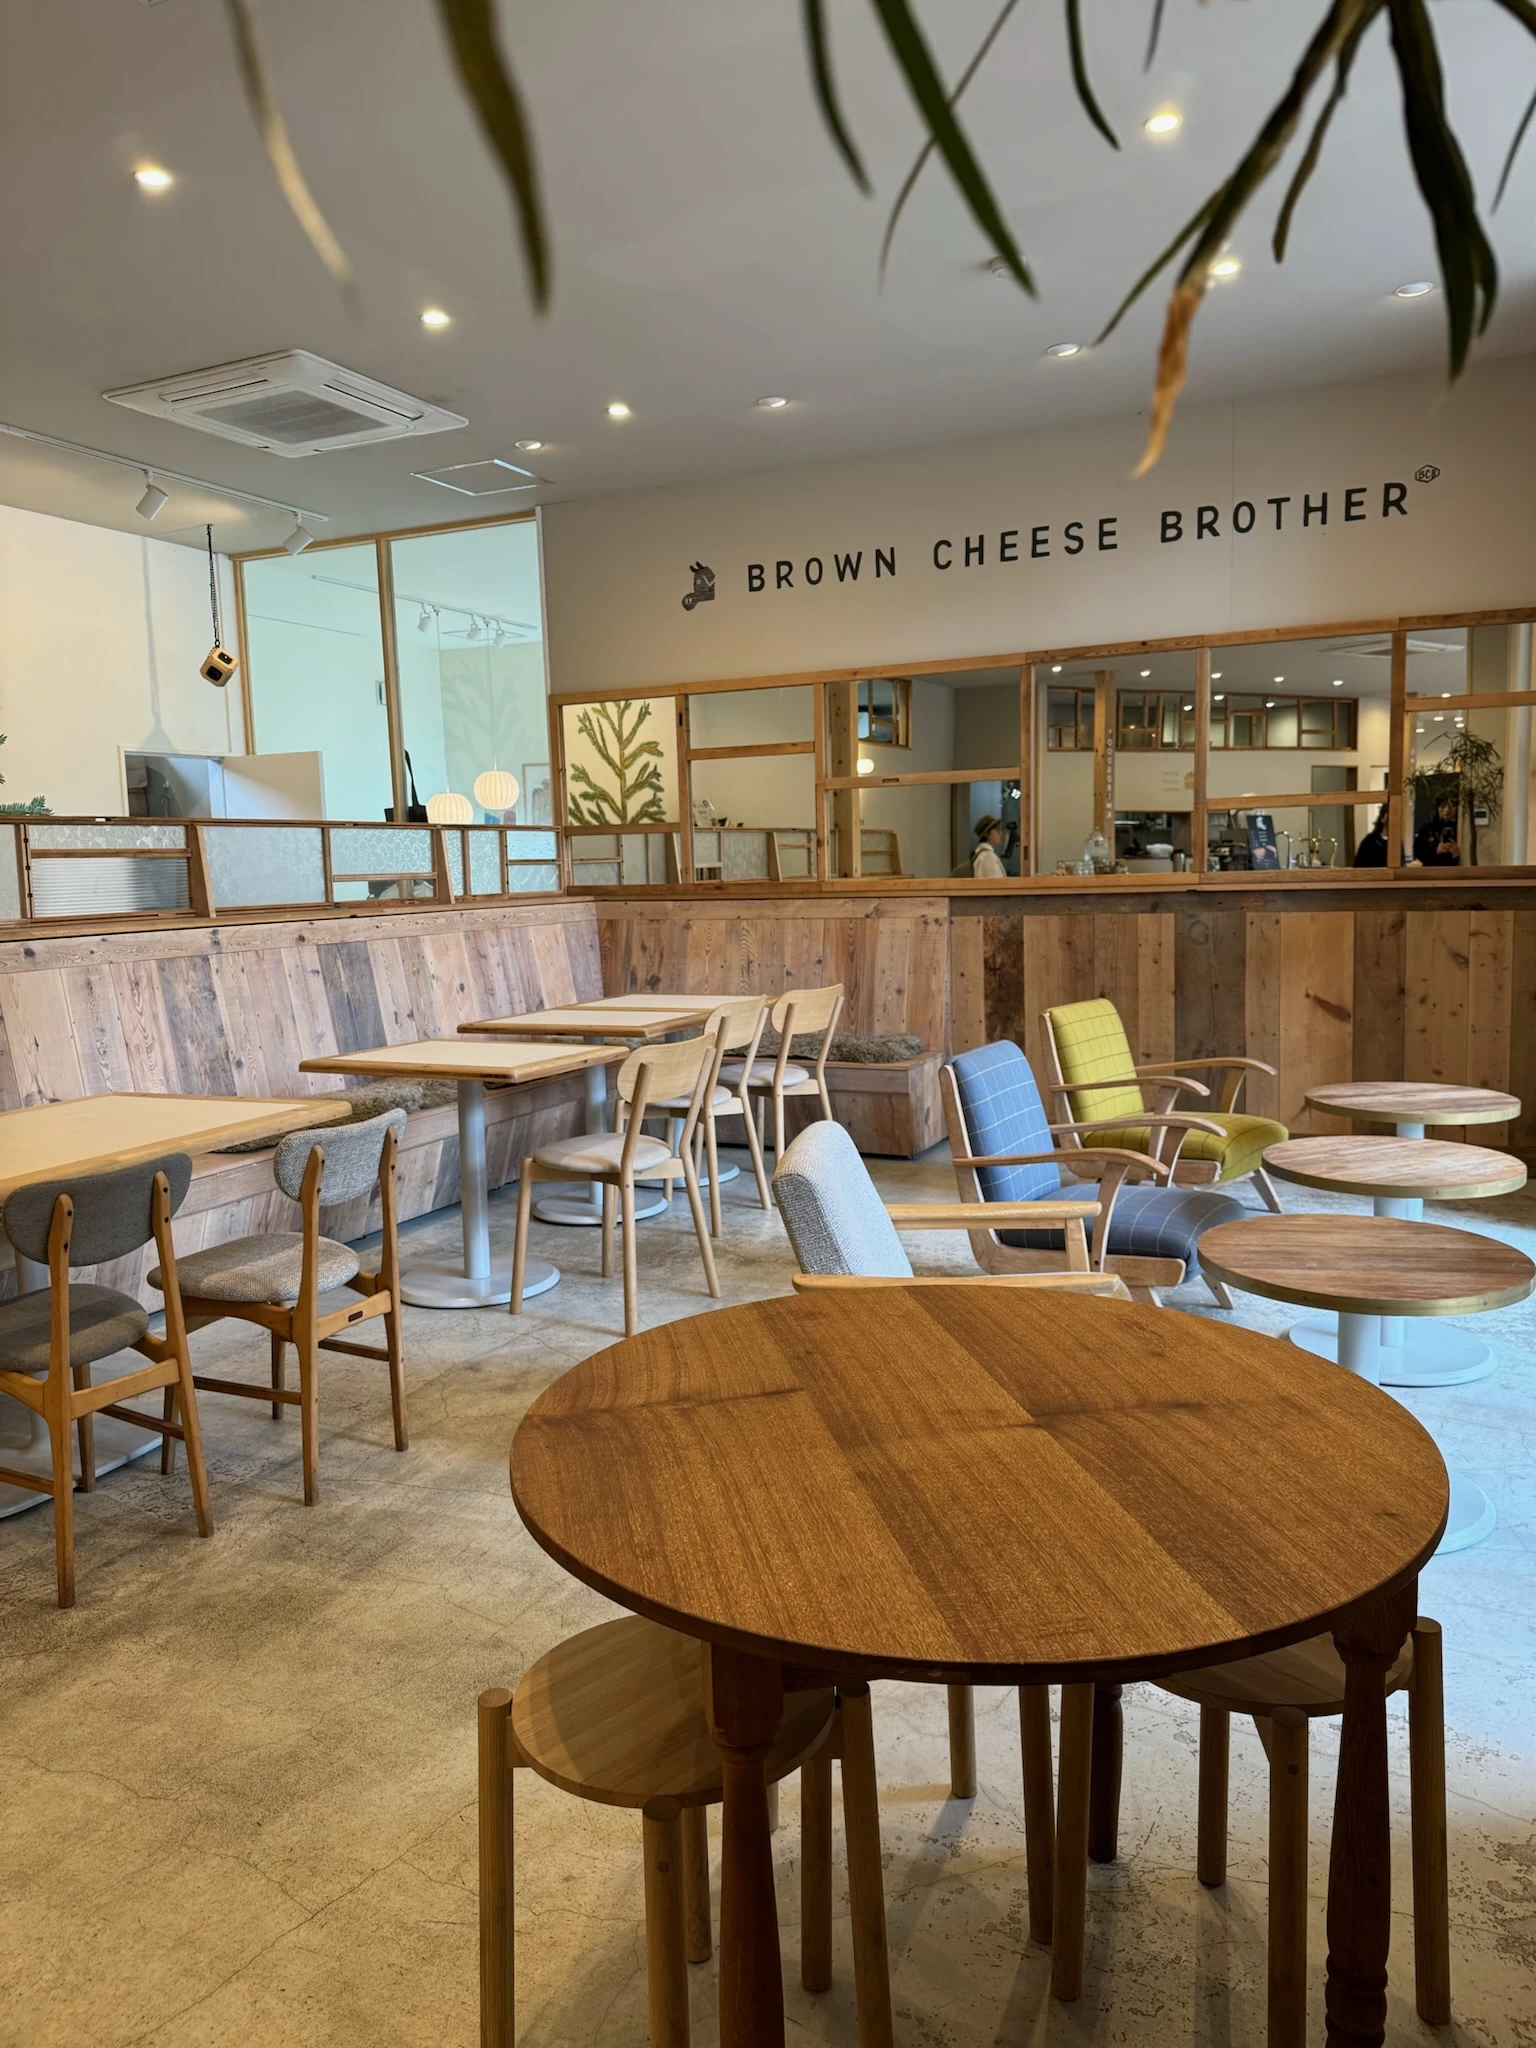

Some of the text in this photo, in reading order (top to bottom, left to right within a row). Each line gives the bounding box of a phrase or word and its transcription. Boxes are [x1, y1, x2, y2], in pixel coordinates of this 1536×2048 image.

[747, 482, 1408, 592] BROWN CHEESE BROTHER
